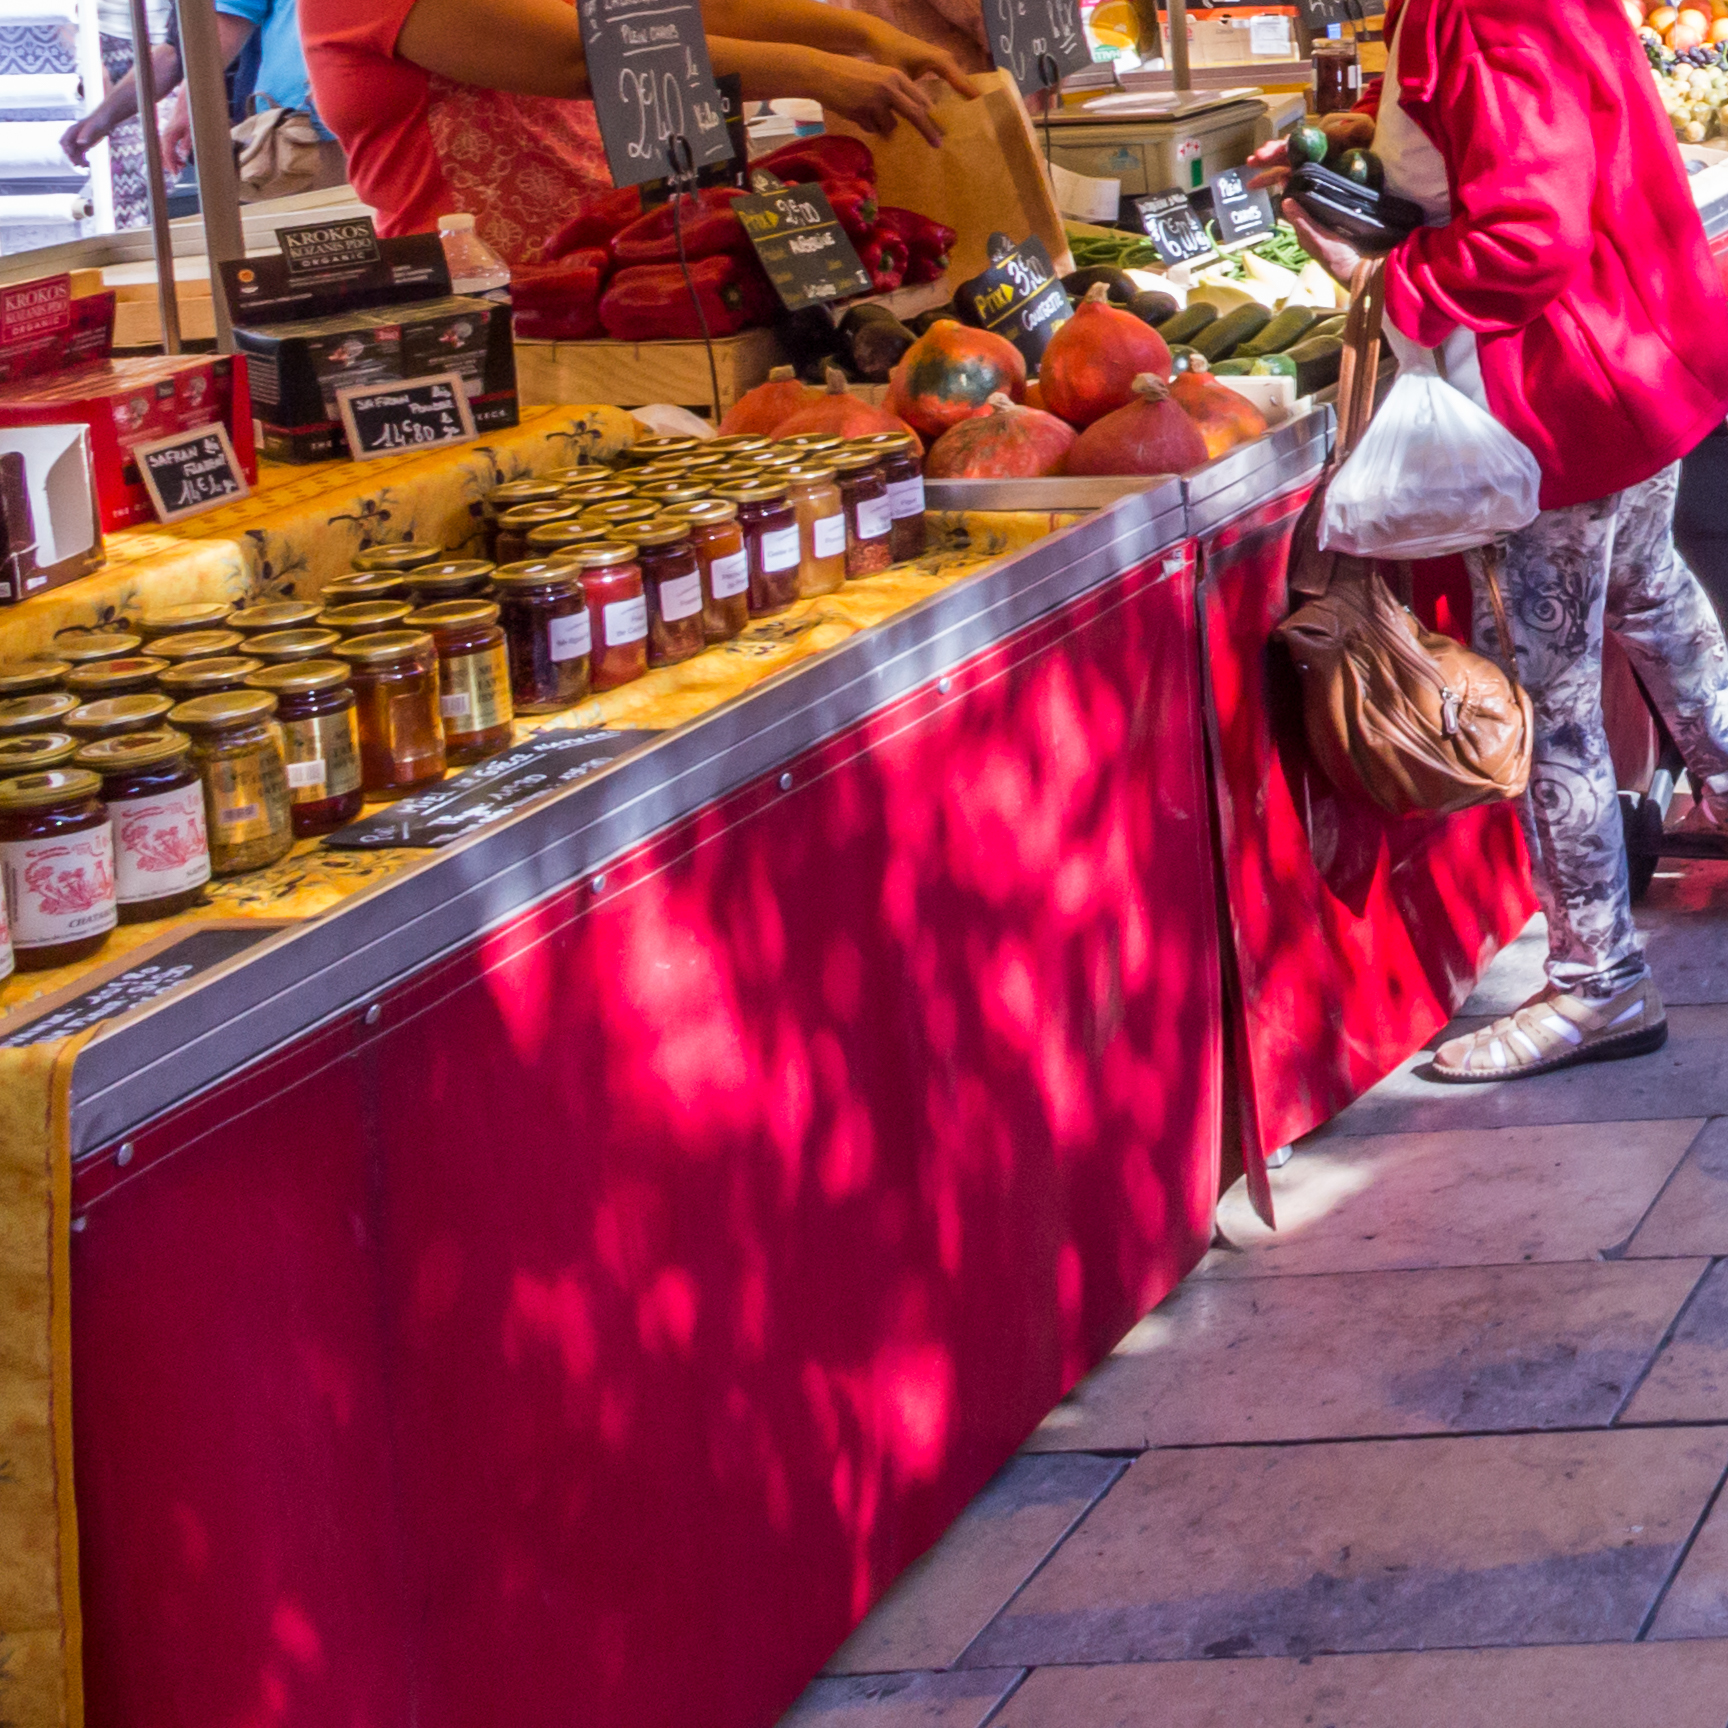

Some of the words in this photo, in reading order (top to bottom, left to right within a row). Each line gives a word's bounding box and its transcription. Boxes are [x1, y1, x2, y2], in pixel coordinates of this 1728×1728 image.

[285, 224, 370, 247] KROKOS
[345, 237, 372, 250] PDO
[301, 252, 365, 267] ORGANIC
[5, 284, 67, 311] KROKOS
[12, 316, 60, 336] ORGANIC
[149, 446, 199, 468] SAFRAN
